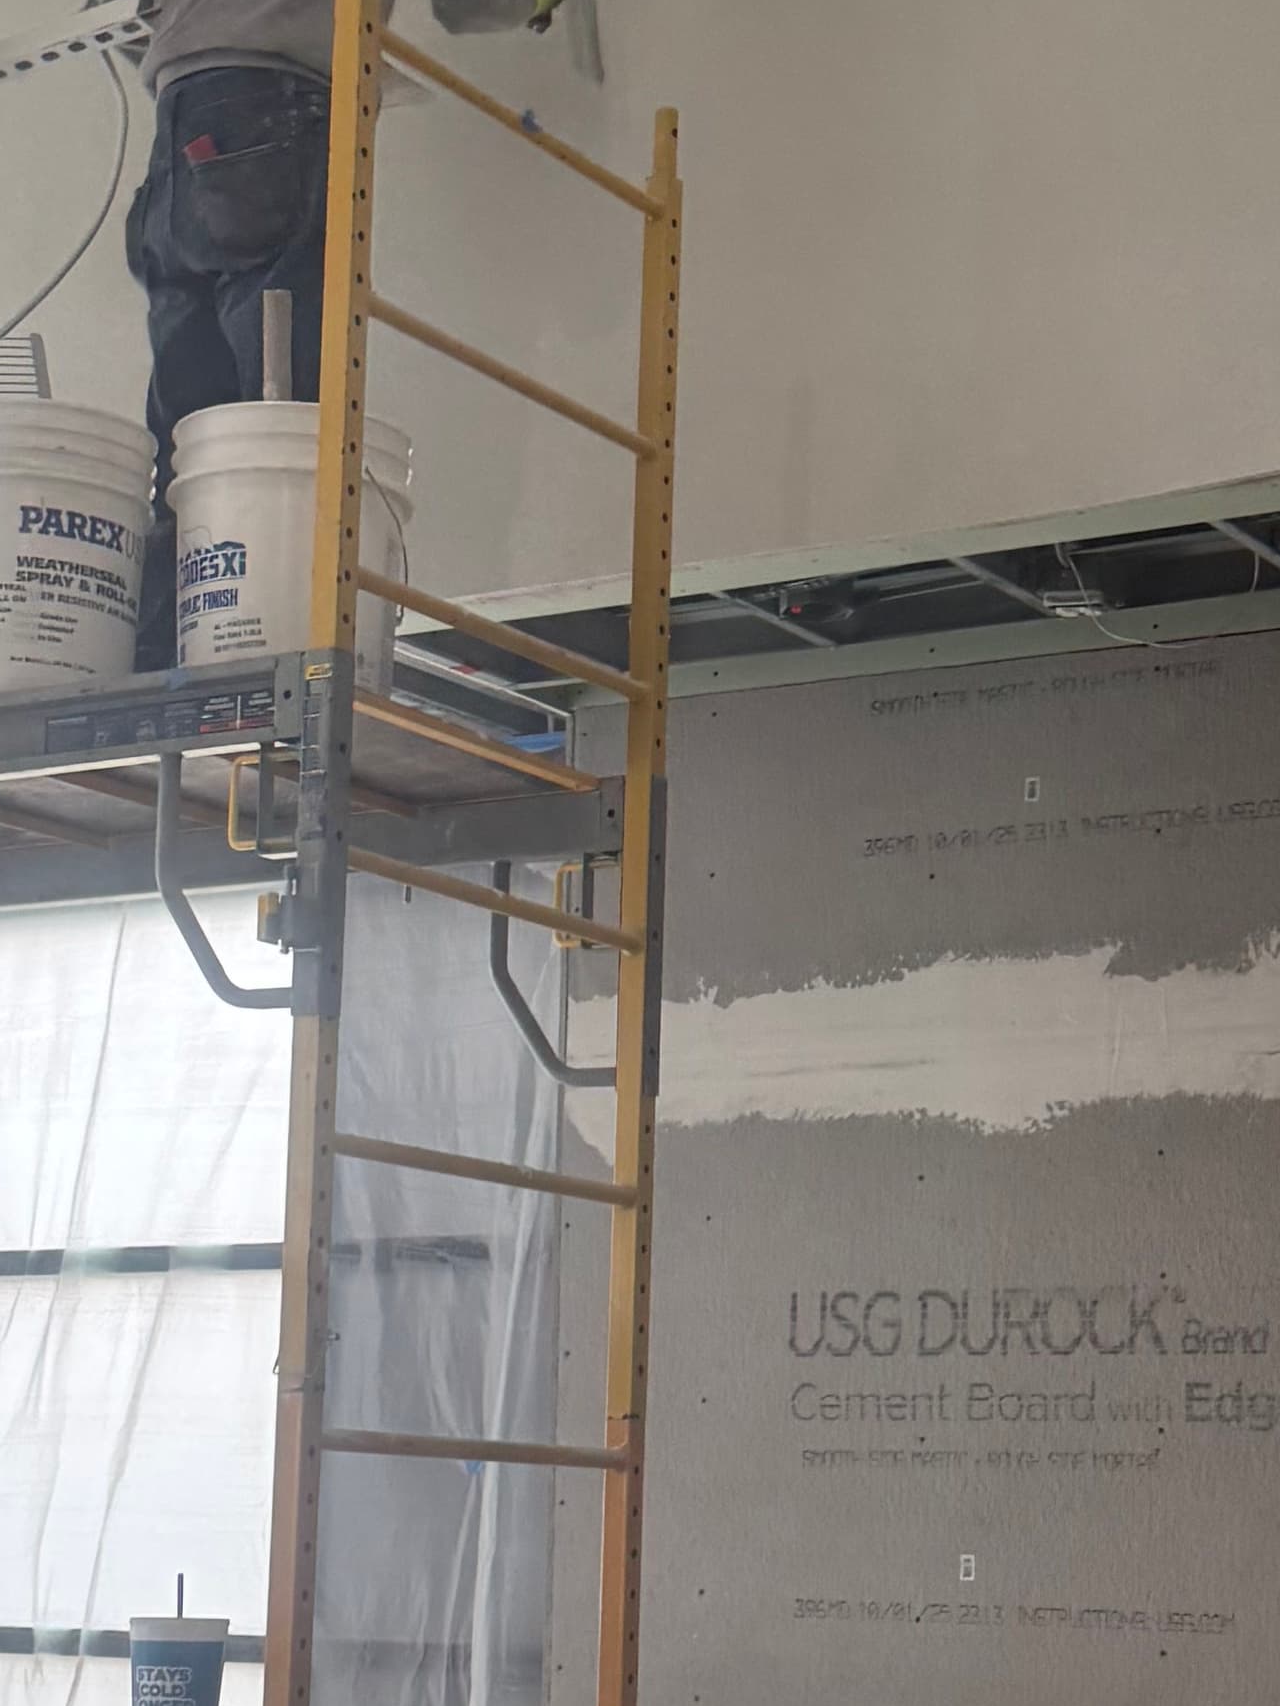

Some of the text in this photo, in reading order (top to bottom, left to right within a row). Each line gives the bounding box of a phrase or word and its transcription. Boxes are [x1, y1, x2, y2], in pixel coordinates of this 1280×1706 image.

[16, 571, 73, 590] SPRAY
[17, 556, 127, 592] WEATHERSEAL
[789, 1291, 902, 1357] USG
[1181, 1318, 1269, 1355] Brand
[790, 1381, 951, 1421] Cement
[967, 1380, 1096, 1421] Board
[1106, 1391, 1170, 1422] with
[136, 1665, 192, 1684] STAYS
[140, 1682, 186, 1698] COLD
